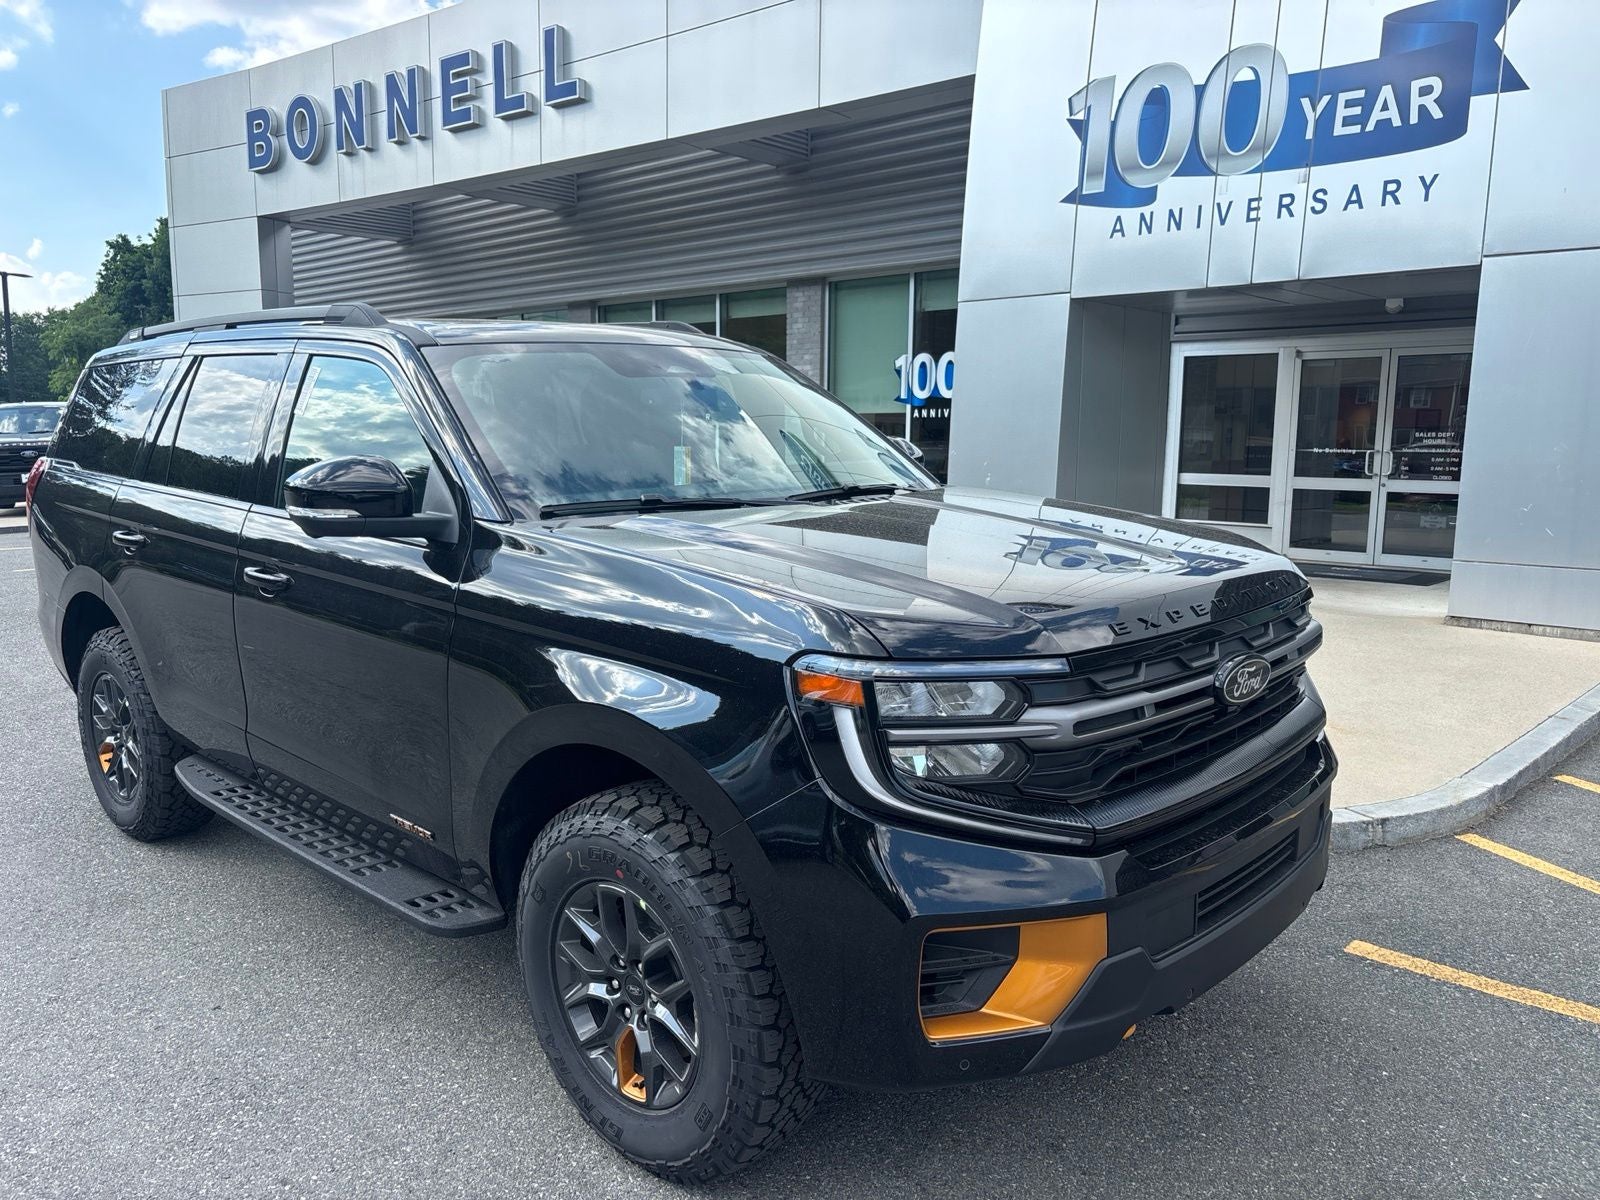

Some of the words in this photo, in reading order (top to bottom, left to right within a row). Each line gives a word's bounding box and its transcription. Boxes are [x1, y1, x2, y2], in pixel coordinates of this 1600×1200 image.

[245, 24, 588, 173] BONNELL
[1068, 42, 1289, 195] 100
[1299, 75, 1444, 141] YEAR
[1109, 173, 1440, 239] ANNIVERSARY
[894, 351, 955, 400] 100
[1108, 574, 1292, 637] EXPEDITION
